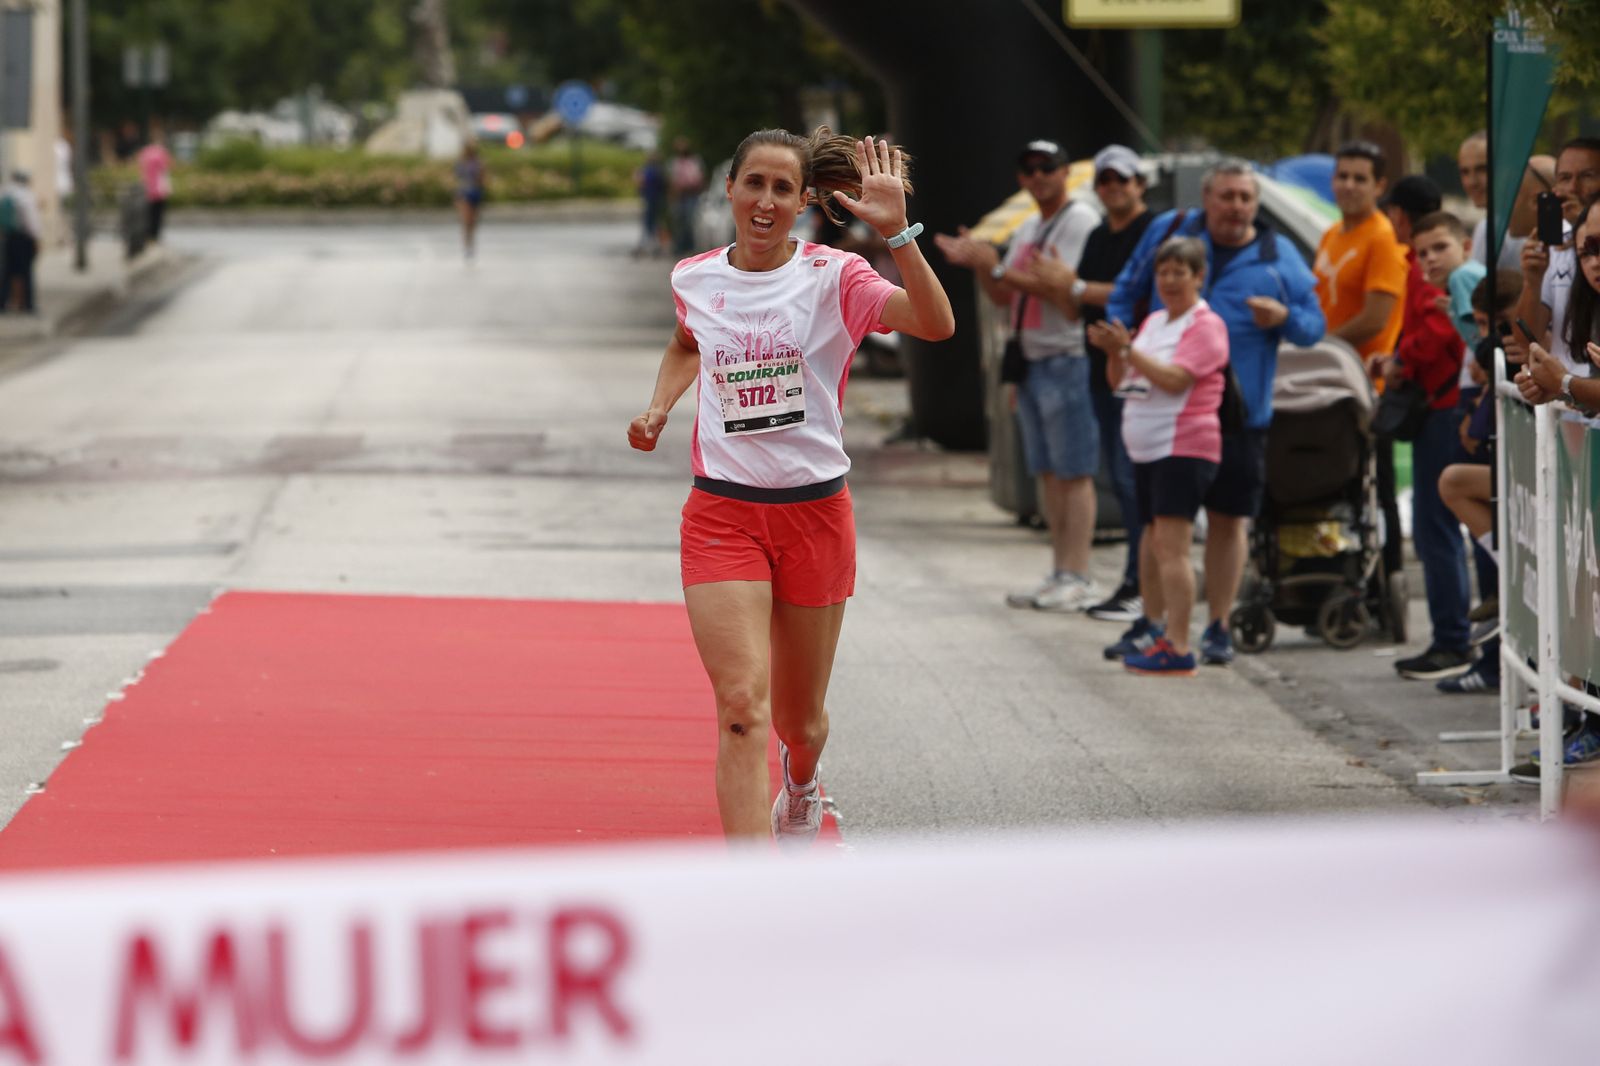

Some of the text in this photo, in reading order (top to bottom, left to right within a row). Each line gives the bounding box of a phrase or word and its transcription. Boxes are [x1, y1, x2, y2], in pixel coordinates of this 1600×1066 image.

[726, 364, 799, 384] COVIRAN
[737, 384, 777, 408] 5772
[113, 904, 633, 1062] MUJER
